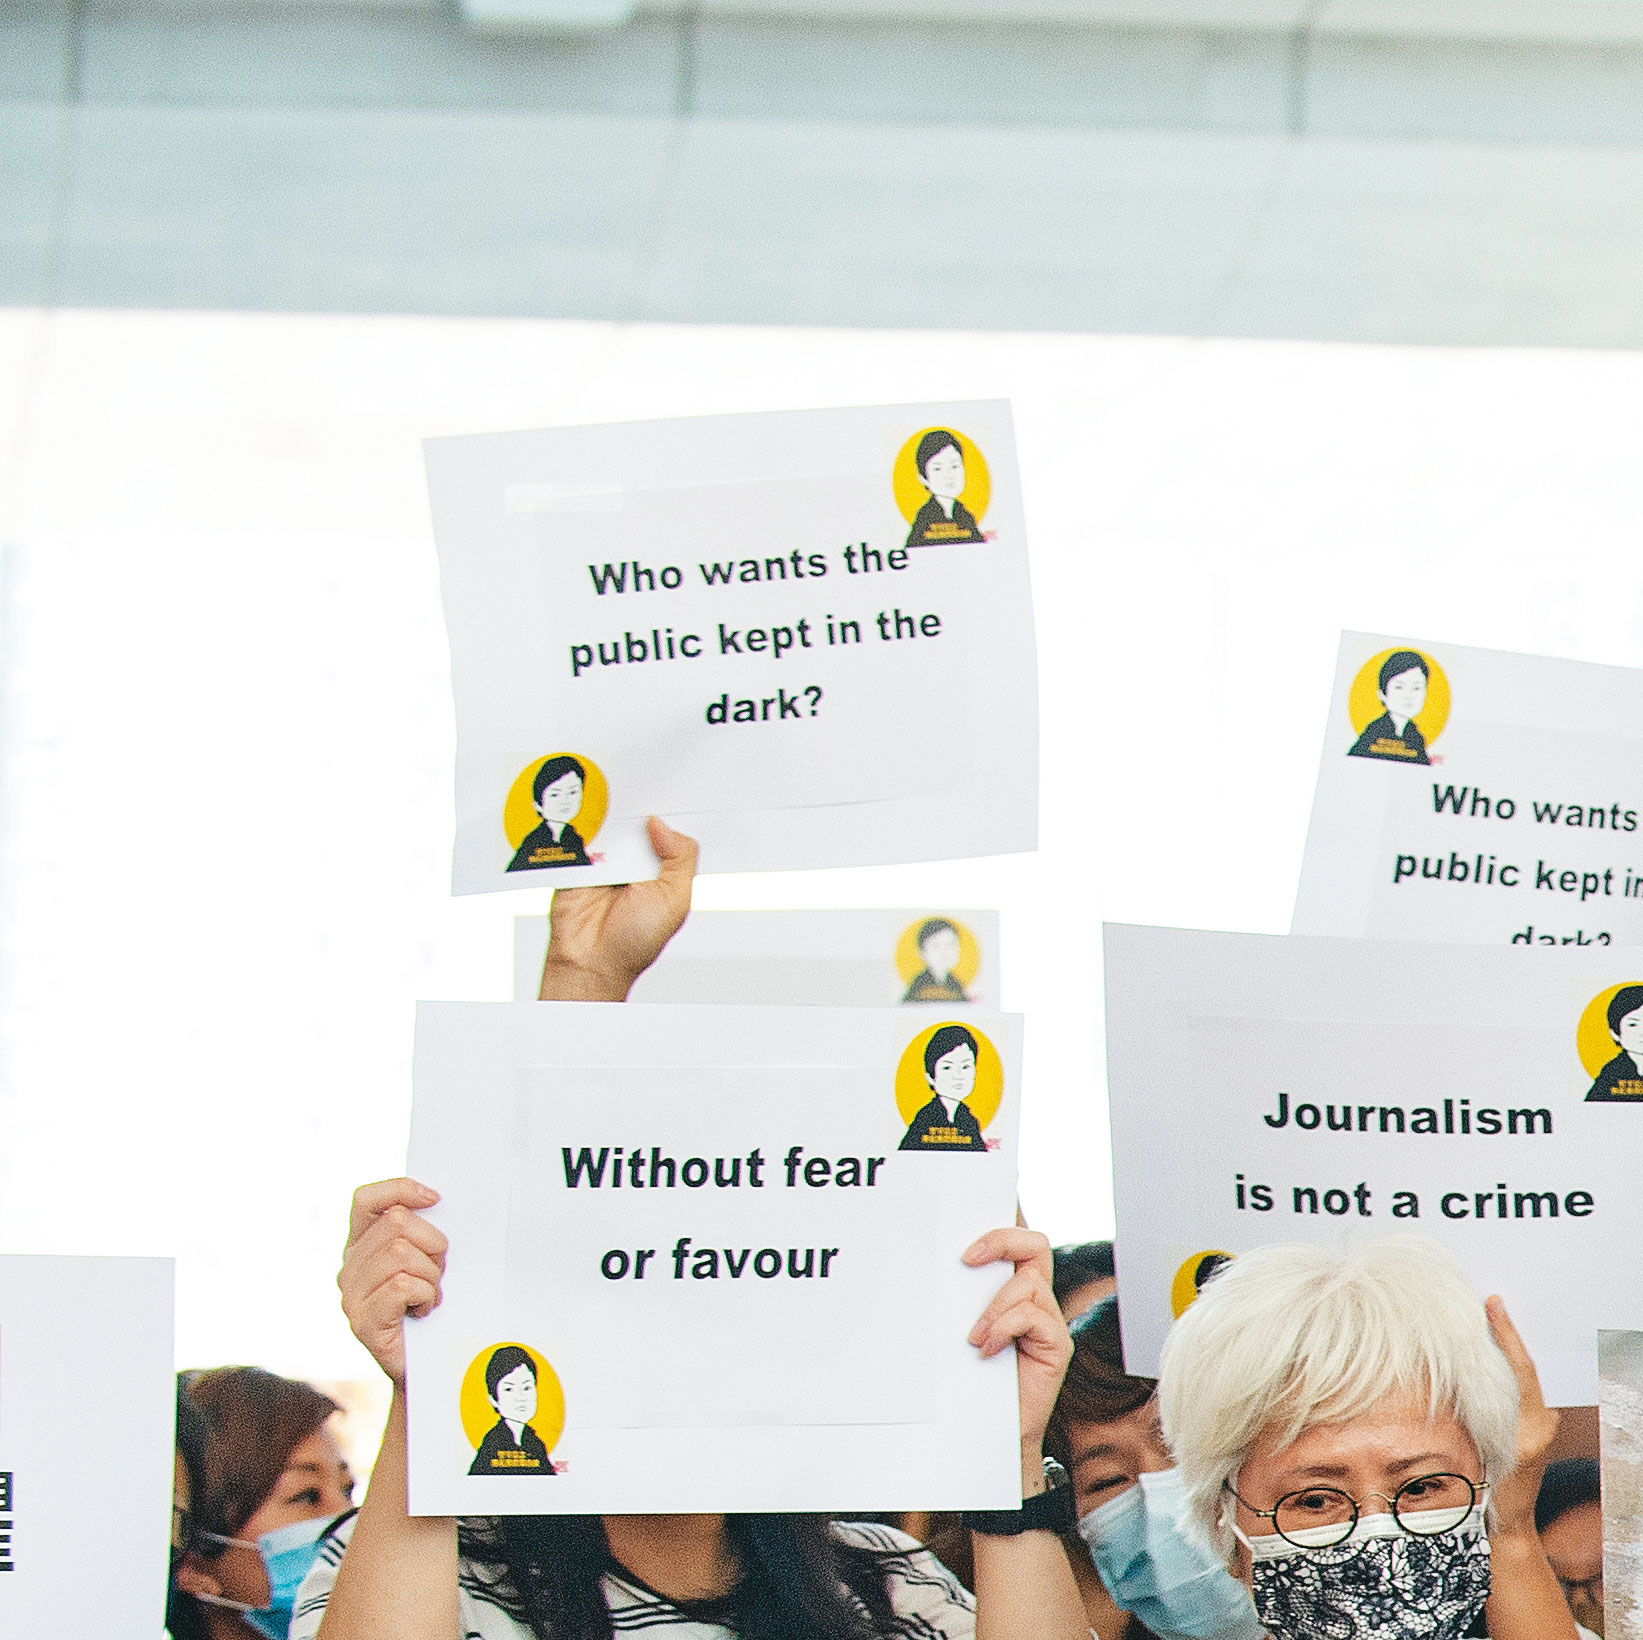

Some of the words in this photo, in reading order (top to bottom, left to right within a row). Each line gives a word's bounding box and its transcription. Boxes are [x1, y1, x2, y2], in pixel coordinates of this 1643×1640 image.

[589, 560, 683, 595] Who
[699, 548, 828, 586] wants
[844, 542, 909, 572] the
[571, 630, 702, 677] public
[719, 618, 813, 658] kept
[826, 614, 862, 645] in
[877, 610, 941, 640] the
[705, 685, 824, 726] dark?
[1433, 784, 1516, 819] Who
[1533, 799, 1637, 832] wants
[1394, 853, 1519, 887] public
[1536, 860, 1613, 901] kept
[1265, 1093, 1553, 1135] Journalism
[562, 1147, 765, 1188] Without
[785, 1147, 886, 1187] fear
[1235, 1173, 1273, 1214] is
[1292, 1182, 1371, 1217] not
[1392, 1190, 1420, 1218] a
[1441, 1183, 1594, 1219] crime
[601, 1247, 655, 1281] or
[673, 1239, 839, 1280] favour
